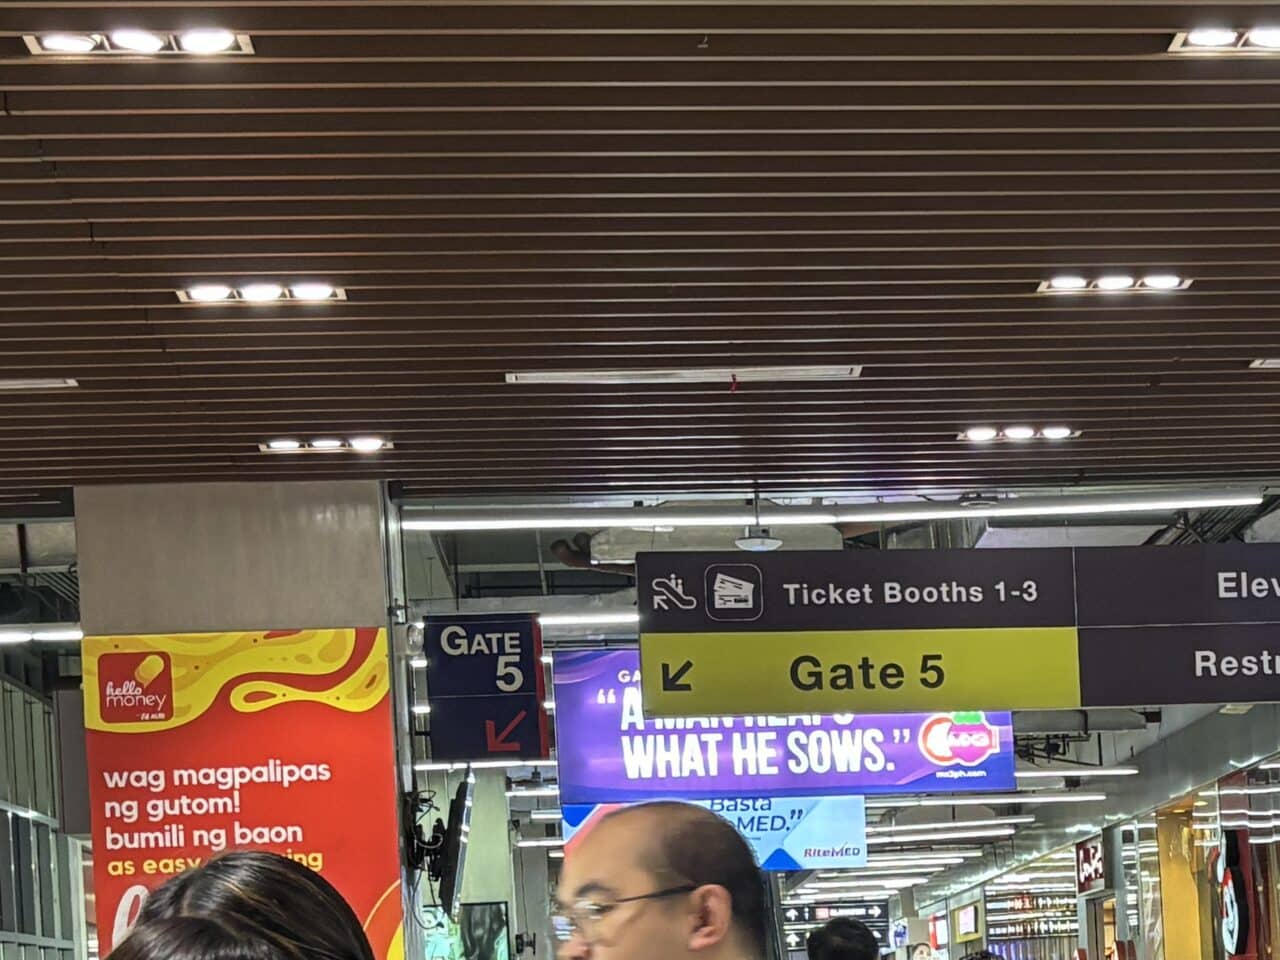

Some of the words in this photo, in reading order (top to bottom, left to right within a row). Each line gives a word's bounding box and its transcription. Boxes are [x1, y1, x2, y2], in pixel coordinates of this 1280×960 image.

[783, 583, 873, 605] Ticket
[884, 581, 983, 604] Booths
[994, 580, 1038, 602] 1-3
[440, 625, 521, 656] GATE
[495, 655, 524, 692] 5
[790, 655, 904, 691] Gate
[919, 654, 945, 689] 5
[106, 681, 143, 696] hello
[106, 694, 167, 711] money
[621, 733, 723, 779] WHAT
[732, 731, 779, 775] HE
[103, 769, 165, 793] wag
[173, 759, 331, 789] magpalipas
[104, 799, 138, 823] ng
[146, 790, 241, 822] gutom!
[709, 798, 773, 813] Basta
[105, 824, 185, 850] bumili
[192, 828, 227, 851] ng
[234, 821, 303, 845] baon
[107, 860, 135, 876] as
[143, 857, 202, 875] easy
